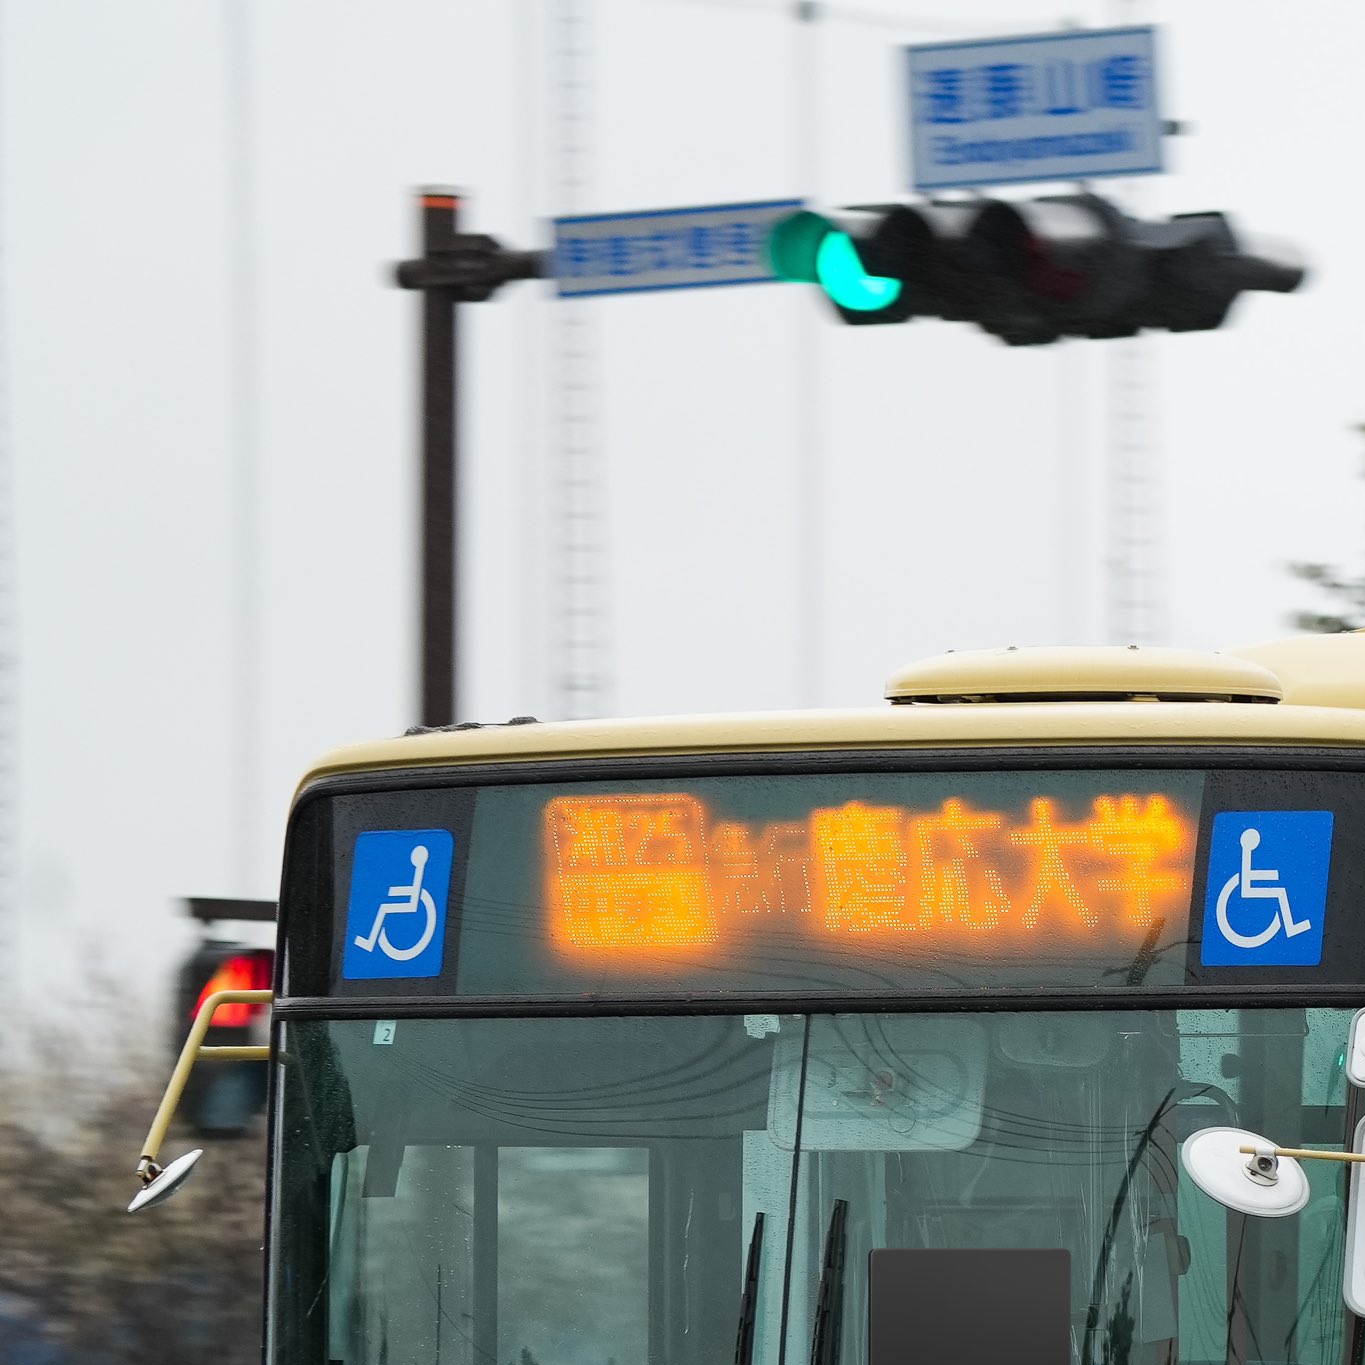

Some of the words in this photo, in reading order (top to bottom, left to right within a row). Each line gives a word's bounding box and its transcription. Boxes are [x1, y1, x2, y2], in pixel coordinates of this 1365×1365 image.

[715, 824, 814, 913] 急行
[820, 797, 1187, 932] 慶応大学
[383, 1028, 391, 1042] 2
